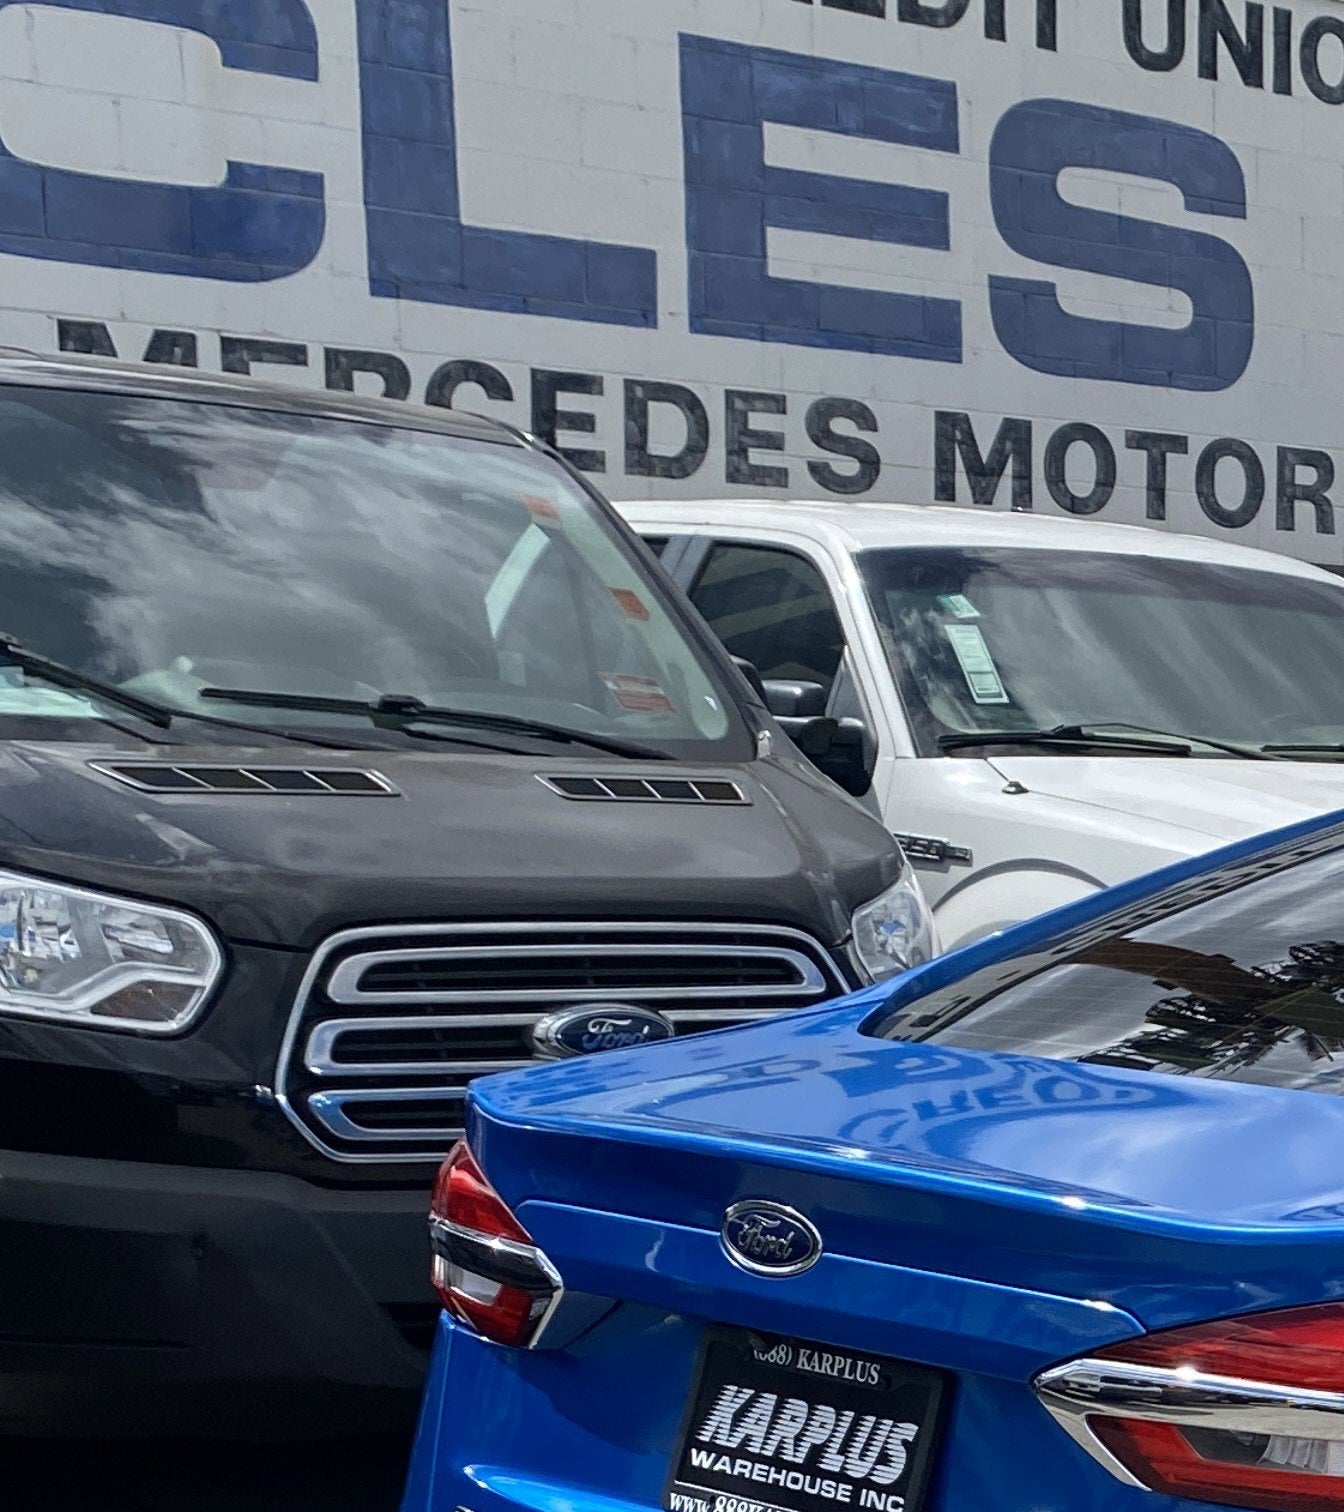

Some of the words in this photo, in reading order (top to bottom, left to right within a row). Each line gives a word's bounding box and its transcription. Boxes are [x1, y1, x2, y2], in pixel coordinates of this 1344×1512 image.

[934, 410, 1337, 535] MOTOR
[737, 1213, 796, 1260] Ford
[796, 1347, 881, 1385] KARPLUS
[694, 1383, 919, 1485] KARPLUS
[690, 1447, 853, 1503] WAREHOUSE
